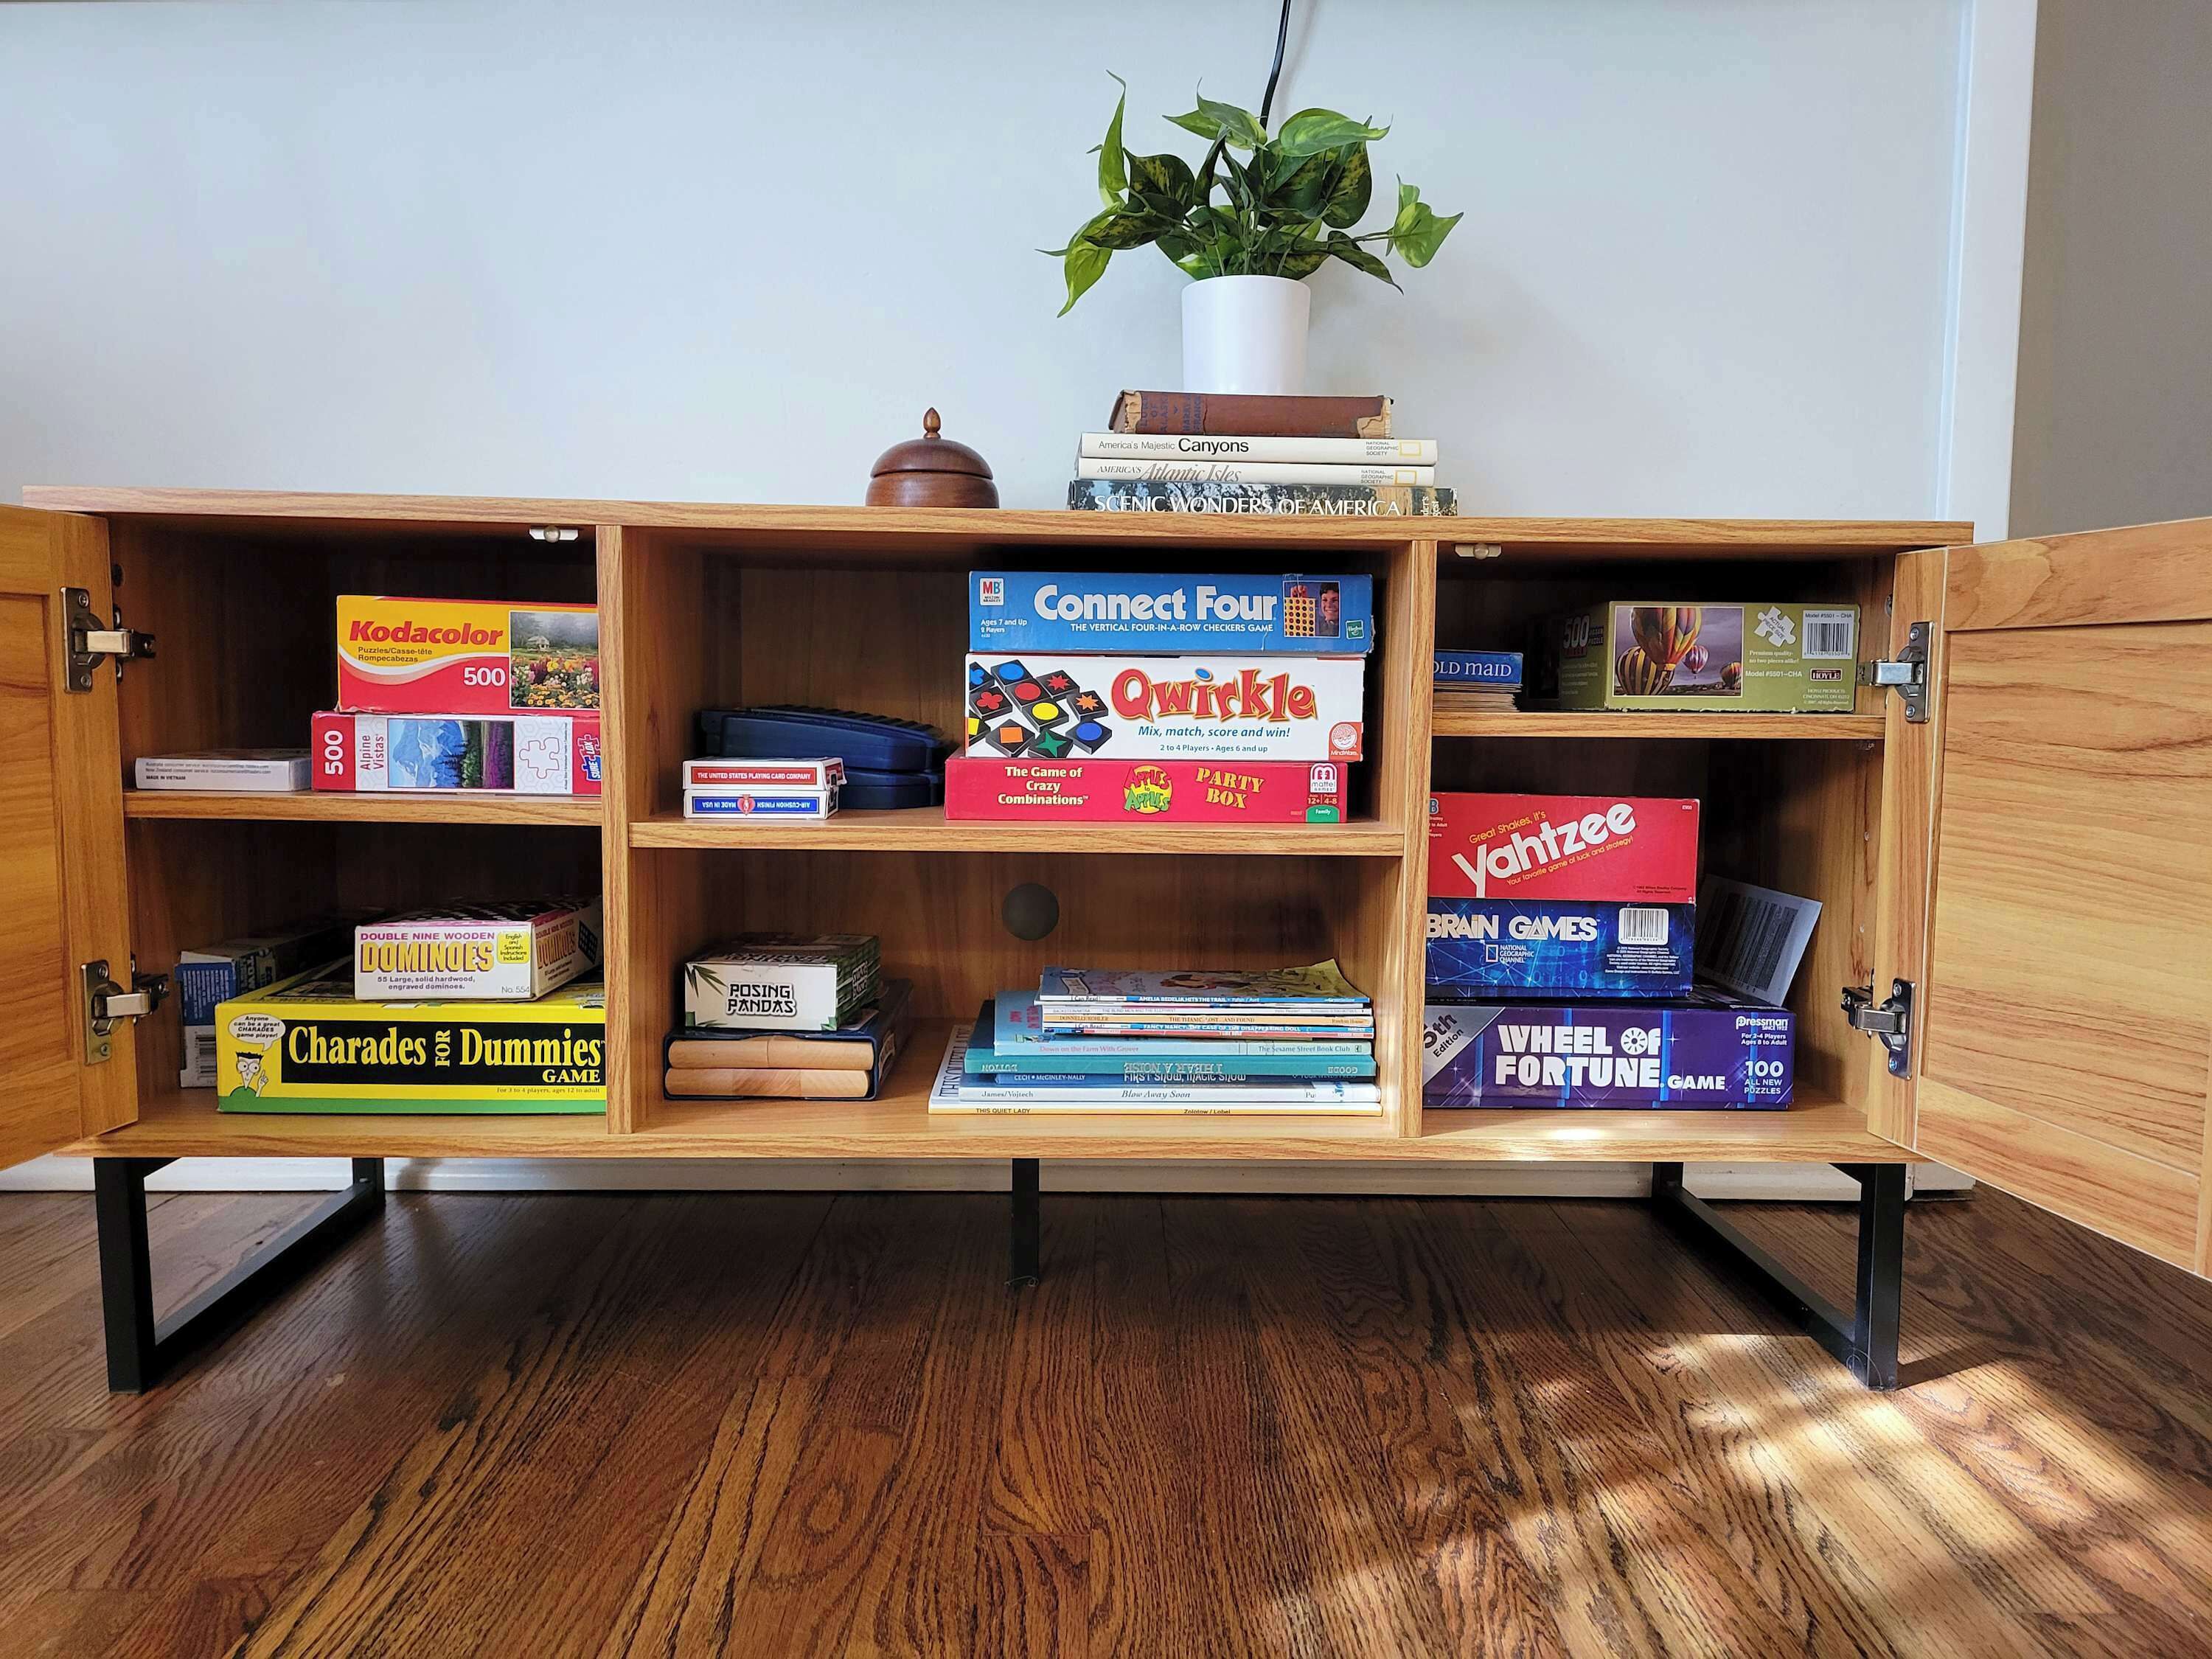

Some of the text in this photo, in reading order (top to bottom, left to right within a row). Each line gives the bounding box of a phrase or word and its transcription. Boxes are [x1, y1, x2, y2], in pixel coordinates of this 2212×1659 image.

[1099, 438, 1249, 455] America's Majestic Canyons
[1136, 463, 1205, 481] Atlantic
[1206, 465, 1242, 482] Isles
[1094, 495, 1401, 516] SCENIC WONDERS OF AMERICA
[983, 581, 1001, 594] MB
[1034, 584, 1277, 622] Connect Four
[349, 620, 504, 646] Kodacolor
[1071, 623, 1273, 633] THE VERTICAL FOUR-IN-A-ROW CHECKERS GAME
[1770, 616, 1787, 632] ACTUAL
[358, 646, 433, 655] Puzzles/Casse-tête
[358, 654, 419, 664] Rompecabezas
[463, 667, 507, 686] 500
[1110, 667, 1318, 723] Qwirkle
[1138, 726, 1290, 737] Mix, match, score and win!
[324, 730, 344, 776] 500
[360, 734, 372, 771] Alpine
[373, 735, 384, 771] Vistas
[1216, 745, 1234, 753] Ages
[1004, 766, 1083, 777] The Game of
[1196, 767, 1263, 793] PARTY
[1026, 780, 1061, 793] Crazy
[1206, 789, 1248, 810] BOX
[1469, 827, 1497, 844] Great
[1497, 815, 1533, 835] Shakes,
[1451, 803, 1636, 898] Yahtzee
[1506, 835, 1634, 886] Your favorite game of luck and strategy!
[444, 932, 495, 940] WOODEN
[1509, 916, 1598, 942] GAMES
[360, 941, 495, 973] DOMINOES
[389, 975, 414, 984] Large,
[435, 975, 476, 984] hardwood,
[729, 984, 790, 999] POSING
[728, 999, 793, 1014] PANDAS
[288, 1026, 426, 1066] Charades
[434, 1029, 451, 1068] FOR
[1433, 1029, 1464, 1057] Edition
[1498, 1025, 1613, 1054] WHEEL
[543, 1069, 600, 1083] GAME
[1124, 1062, 1222, 1074] I HEAR A NOISE
[1495, 1056, 1661, 1089] FORTUNE
[1745, 1060, 1784, 1077] 100
[1667, 1075, 1726, 1091] GAME
[1121, 1090, 1191, 1099] Blow Away Soon
